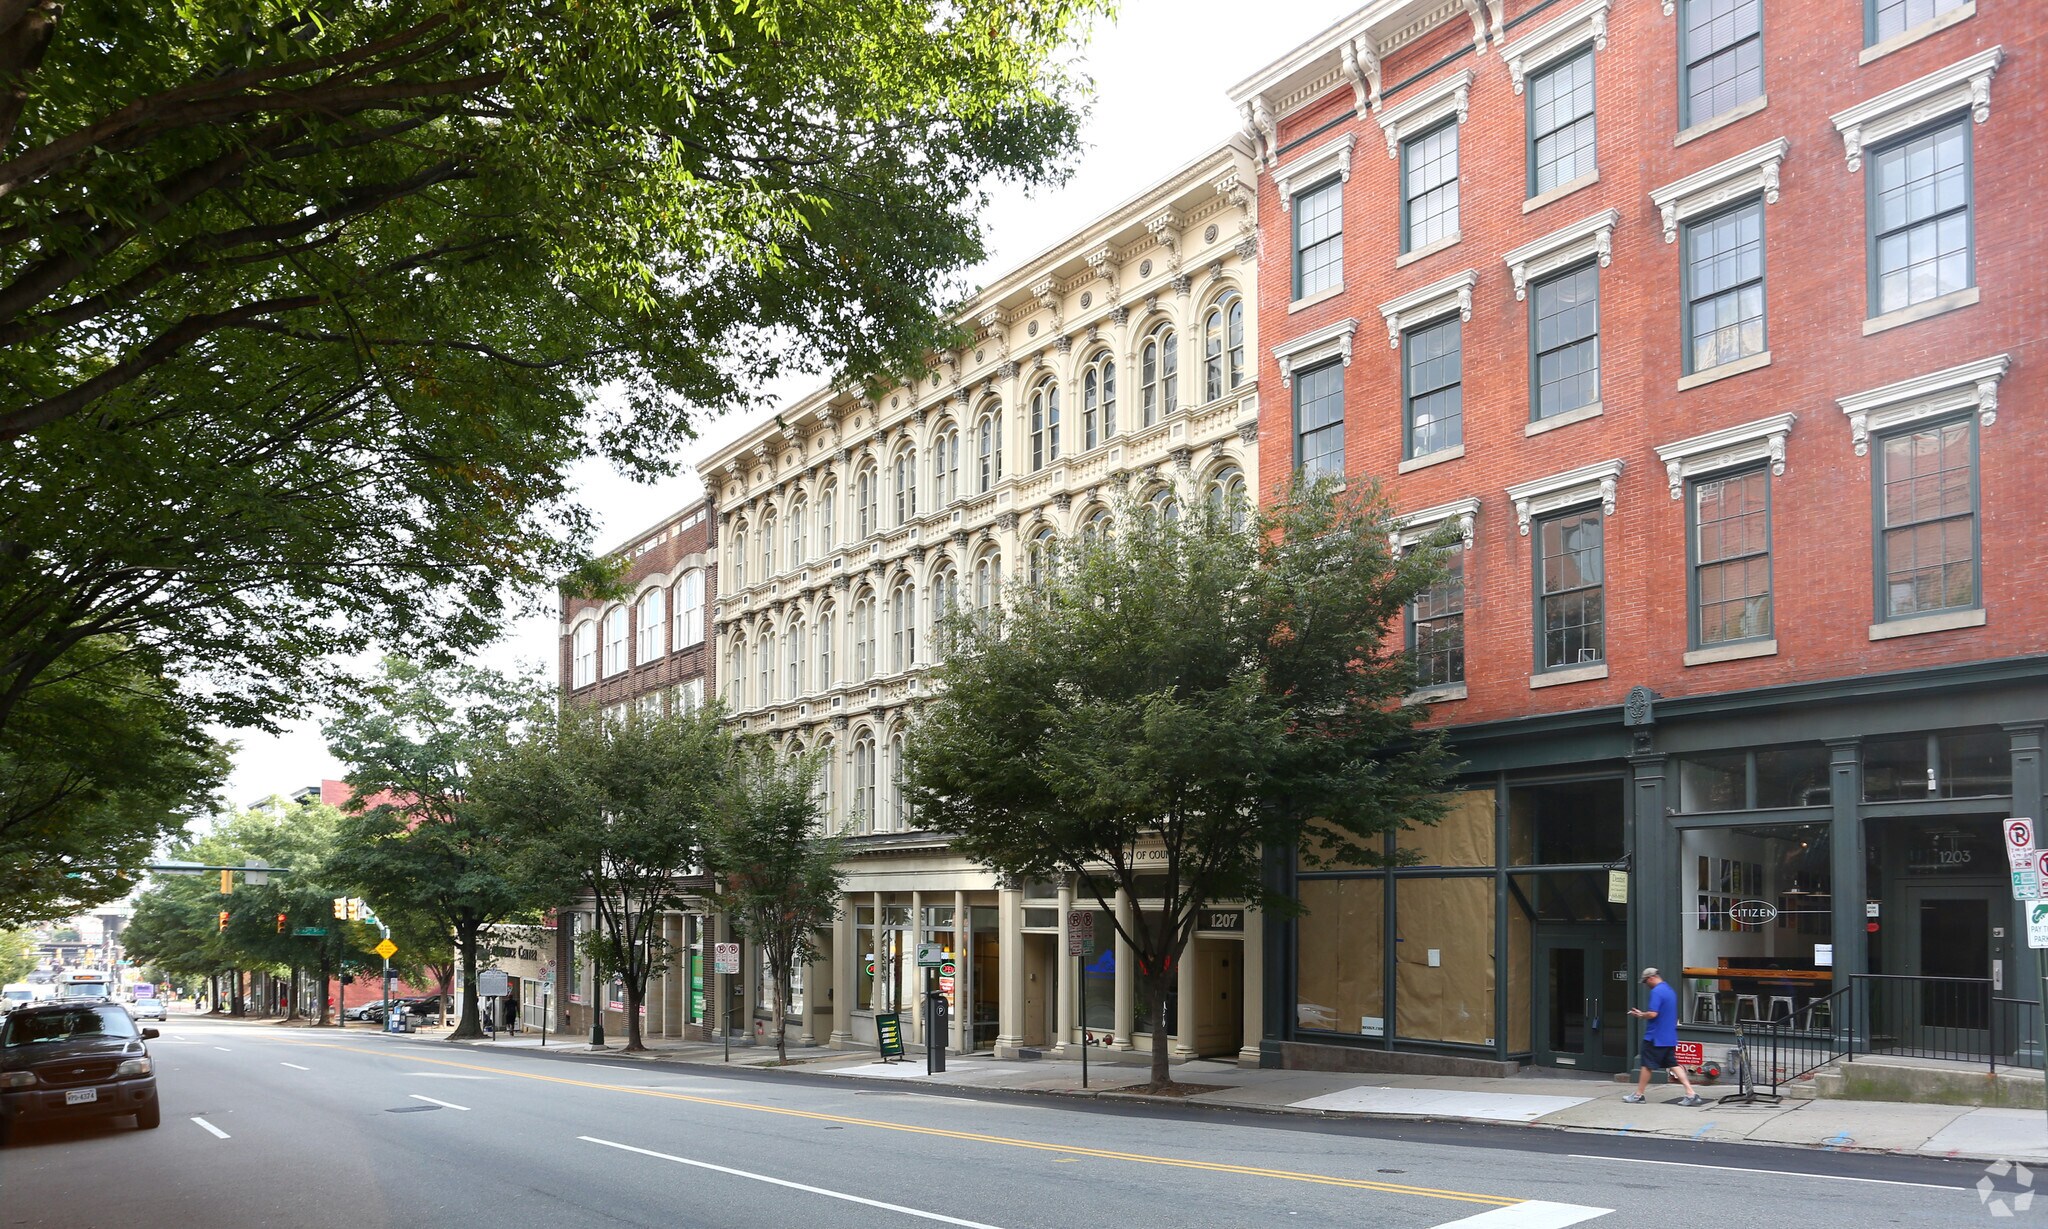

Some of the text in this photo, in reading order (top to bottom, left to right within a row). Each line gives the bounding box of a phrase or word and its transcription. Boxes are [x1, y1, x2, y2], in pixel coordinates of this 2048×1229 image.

[1136, 851, 1147, 860] OF
[1939, 850, 1971, 863] 1203
[2014, 875, 2020, 884] 2
[1730, 908, 1775, 918] CITIZEN
[1211, 913, 1238, 928] 1207
[2031, 925, 2042, 933] PAY
[1675, 1043, 1696, 1053] FDC
